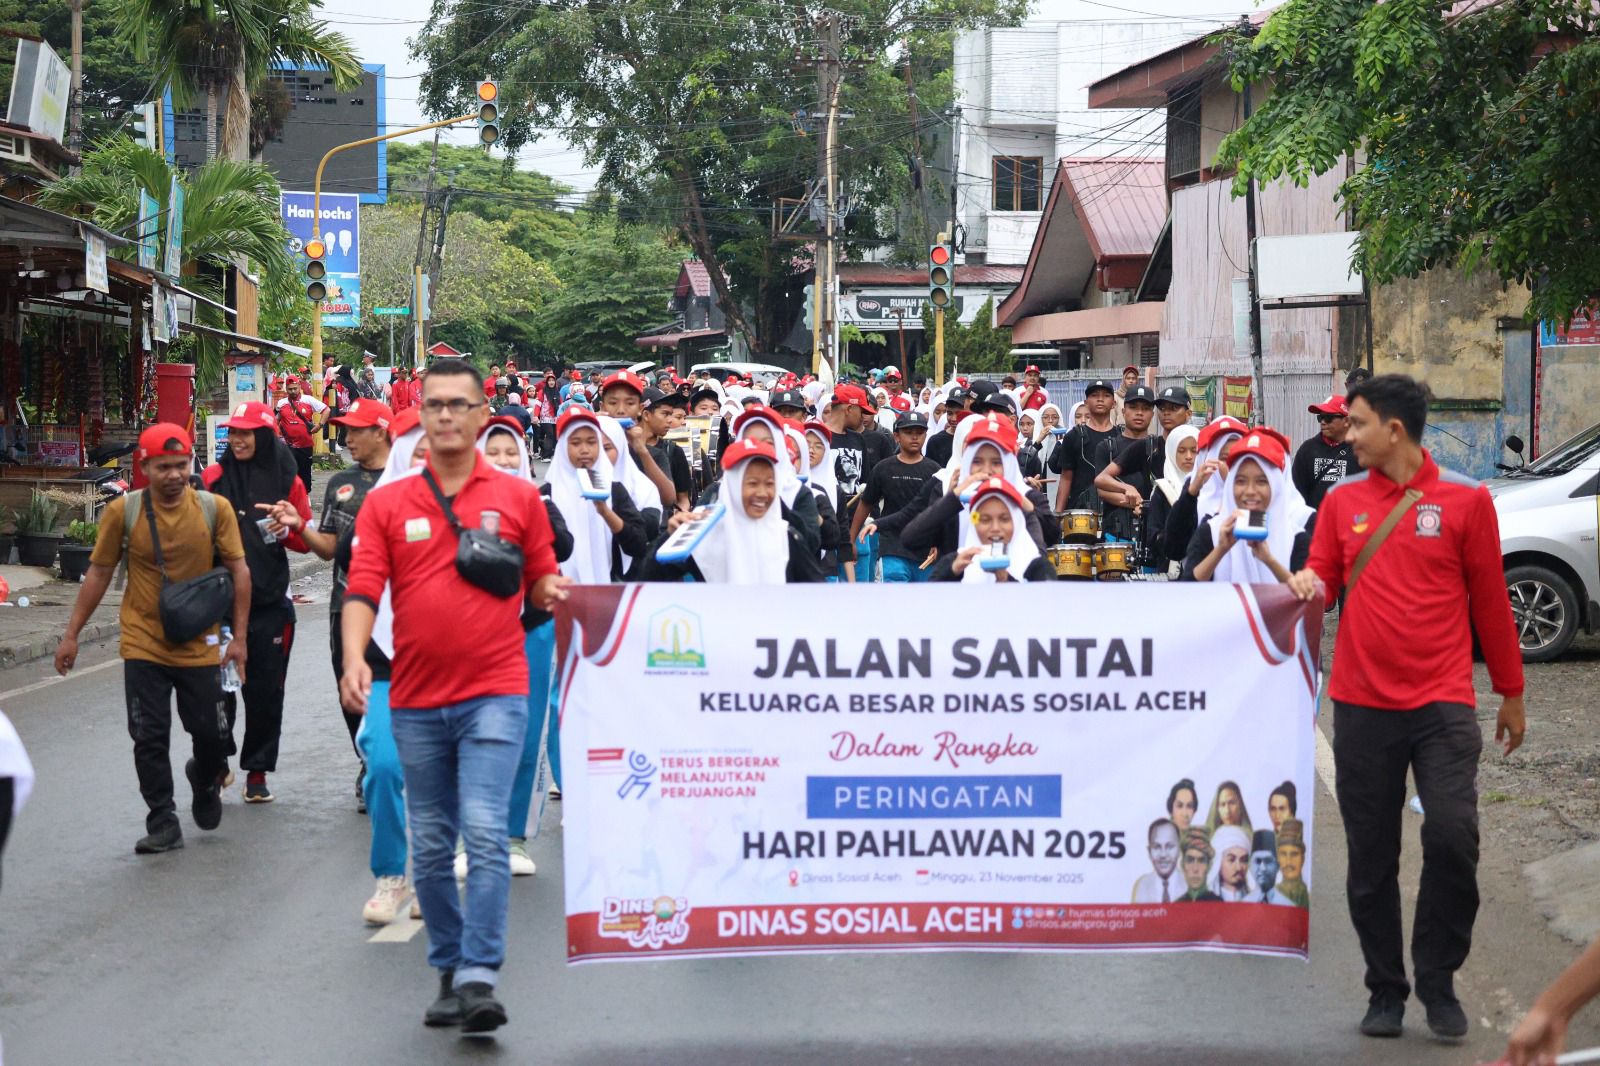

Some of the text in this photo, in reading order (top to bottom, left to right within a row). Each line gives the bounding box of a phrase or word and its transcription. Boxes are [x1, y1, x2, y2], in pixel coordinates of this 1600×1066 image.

[889, 298, 917, 308] RUMAH
[753, 637, 1153, 679] JALAN SANTAI
[700, 691, 1206, 713] KELUARGA BESAR DINAS SOSIAL ACEH
[829, 731, 1039, 768] Dalam Rangka
[661, 756, 780, 768] TERUS BERGERAK
[661, 771, 766, 783] MELANJUTKAN
[661, 786, 757, 798] PERJUANGAN
[835, 785, 1033, 809] PERINGATAN
[743, 829, 1127, 860] HARI PAHLAWAN 2025
[802, 872, 902, 883] Dinas Sosial Aceh
[931, 872, 1084, 884] Minggu, 23 November 2025
[717, 906, 1003, 937] DINAS SOSIAL ACEH
[1025, 918, 1135, 931] dinsos.acehprov.go.id
